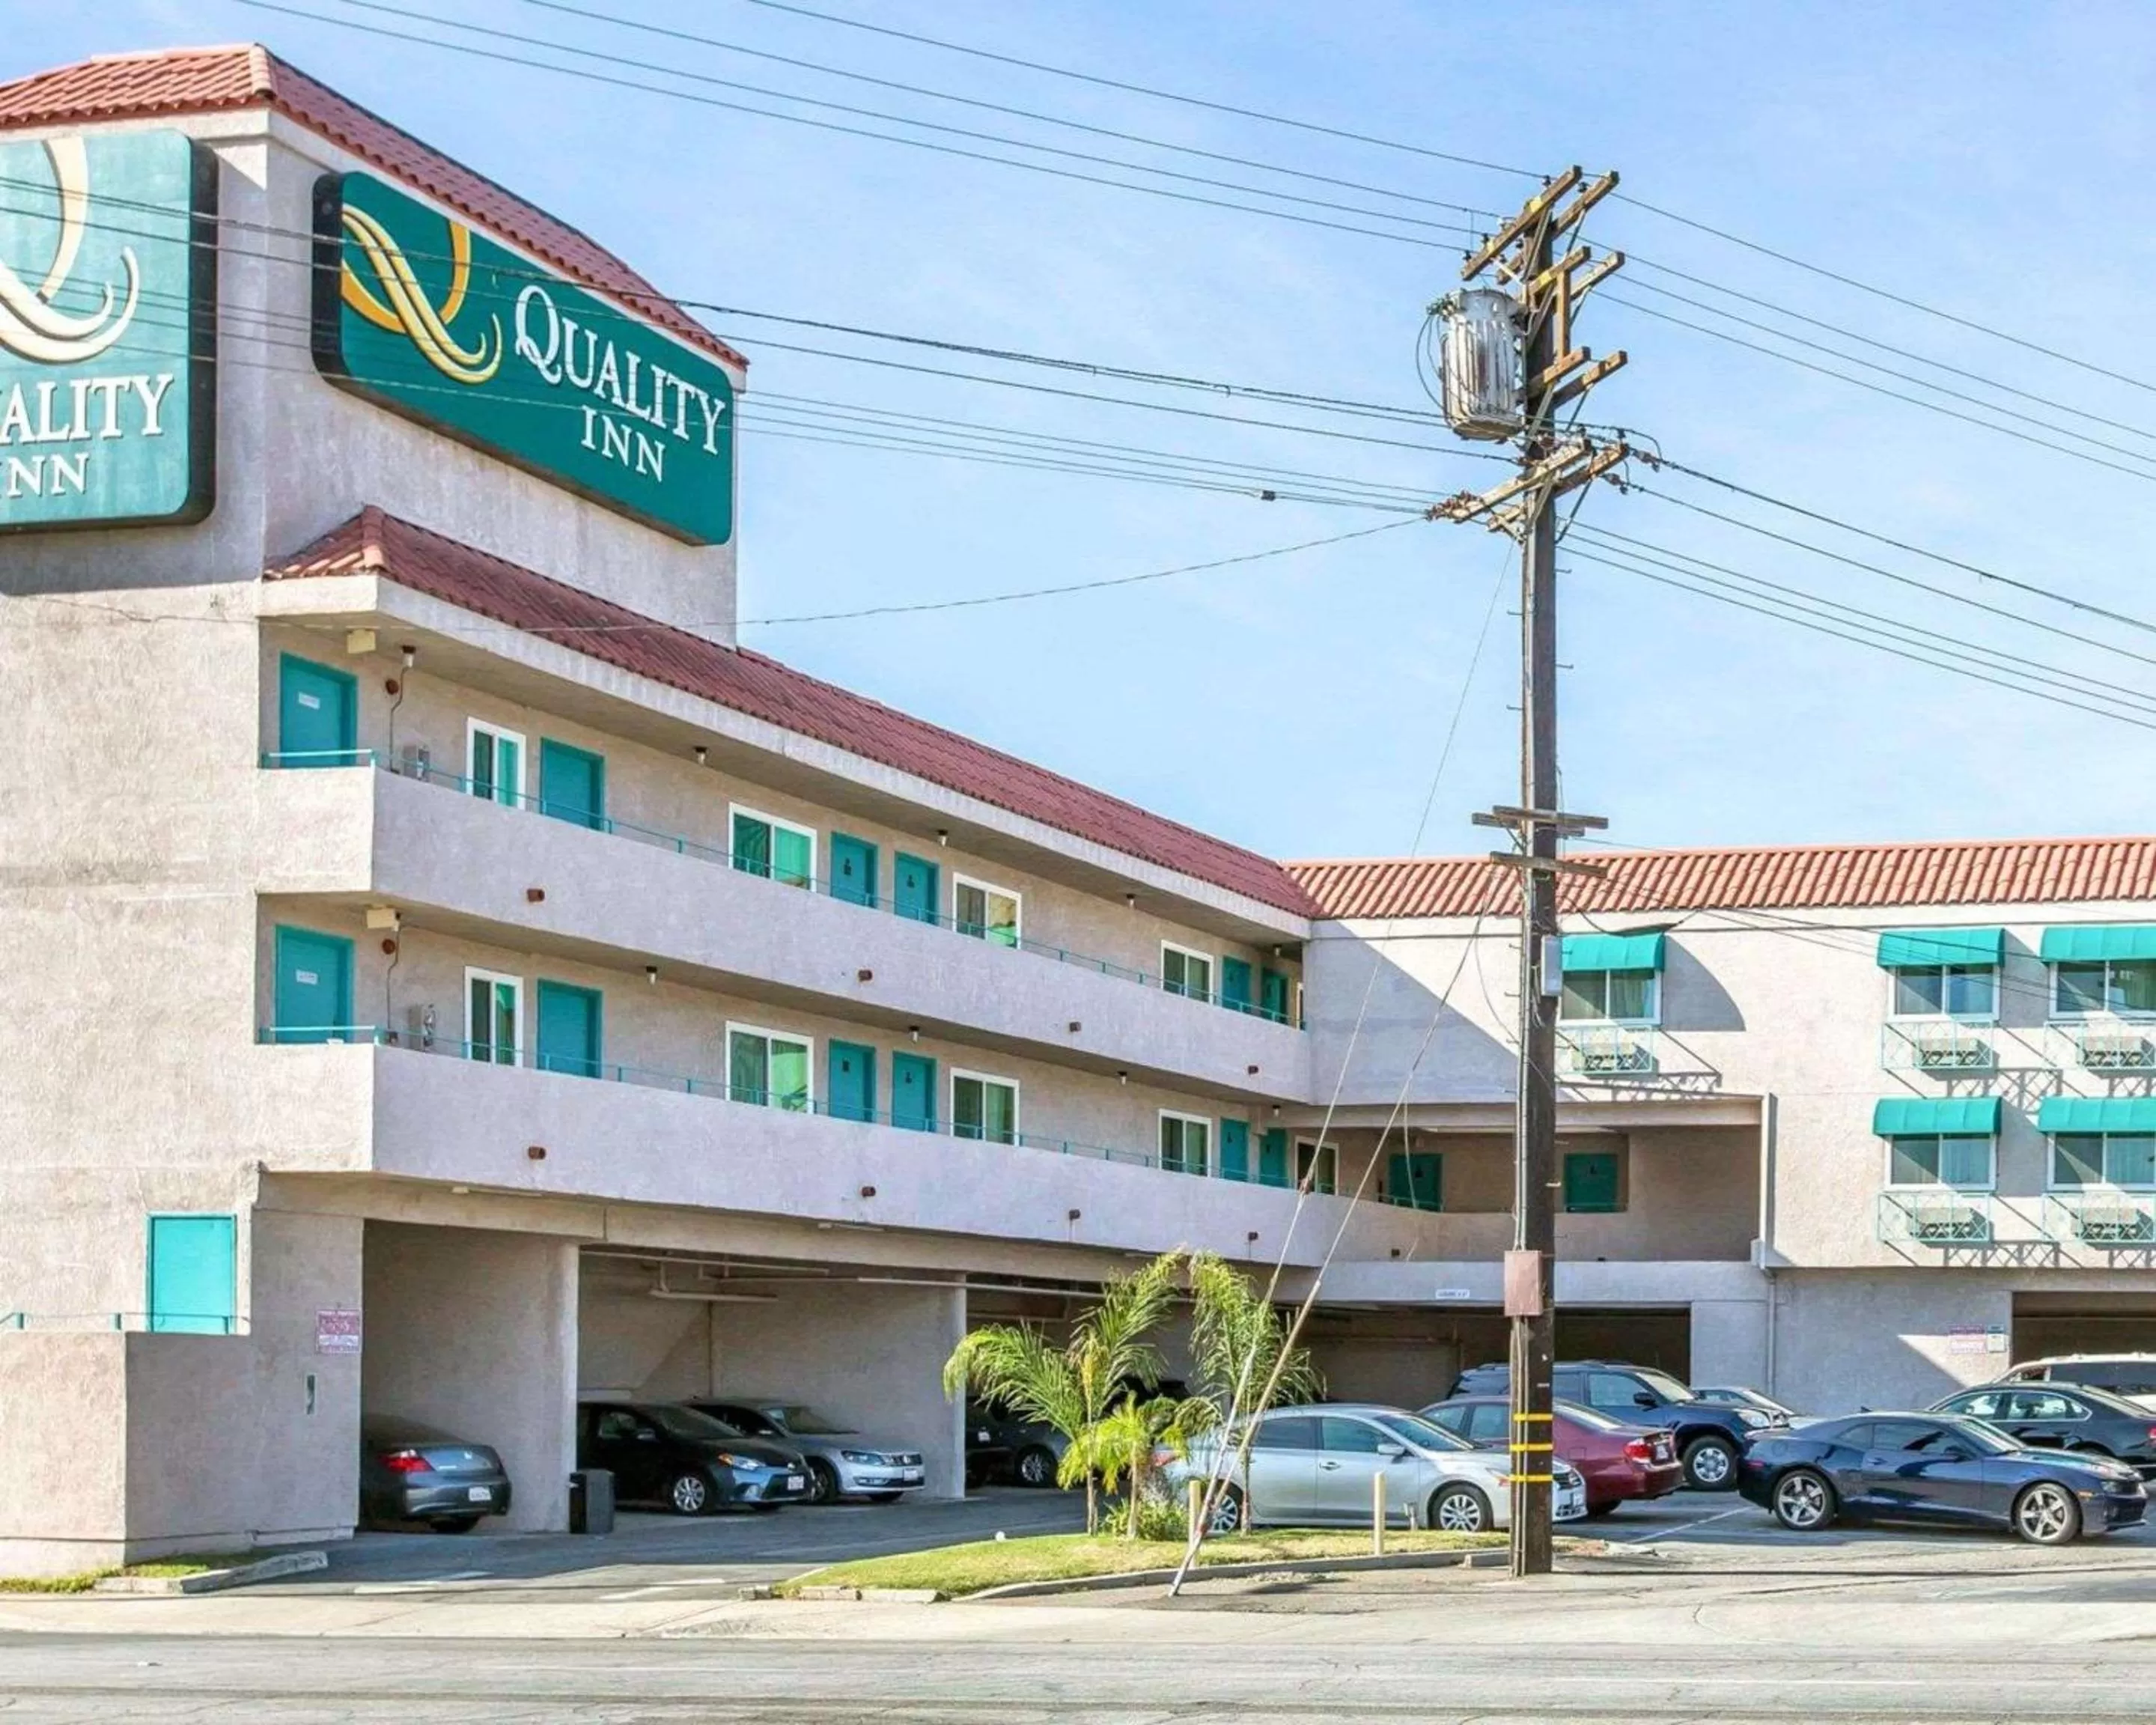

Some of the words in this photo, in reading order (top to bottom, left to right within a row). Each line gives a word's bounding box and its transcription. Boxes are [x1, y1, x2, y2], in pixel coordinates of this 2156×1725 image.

[515, 285, 726, 455] QUALITY
[0, 373, 174, 445] ALITY
[581, 404, 666, 482] INN
[0, 452, 88, 497] NN
